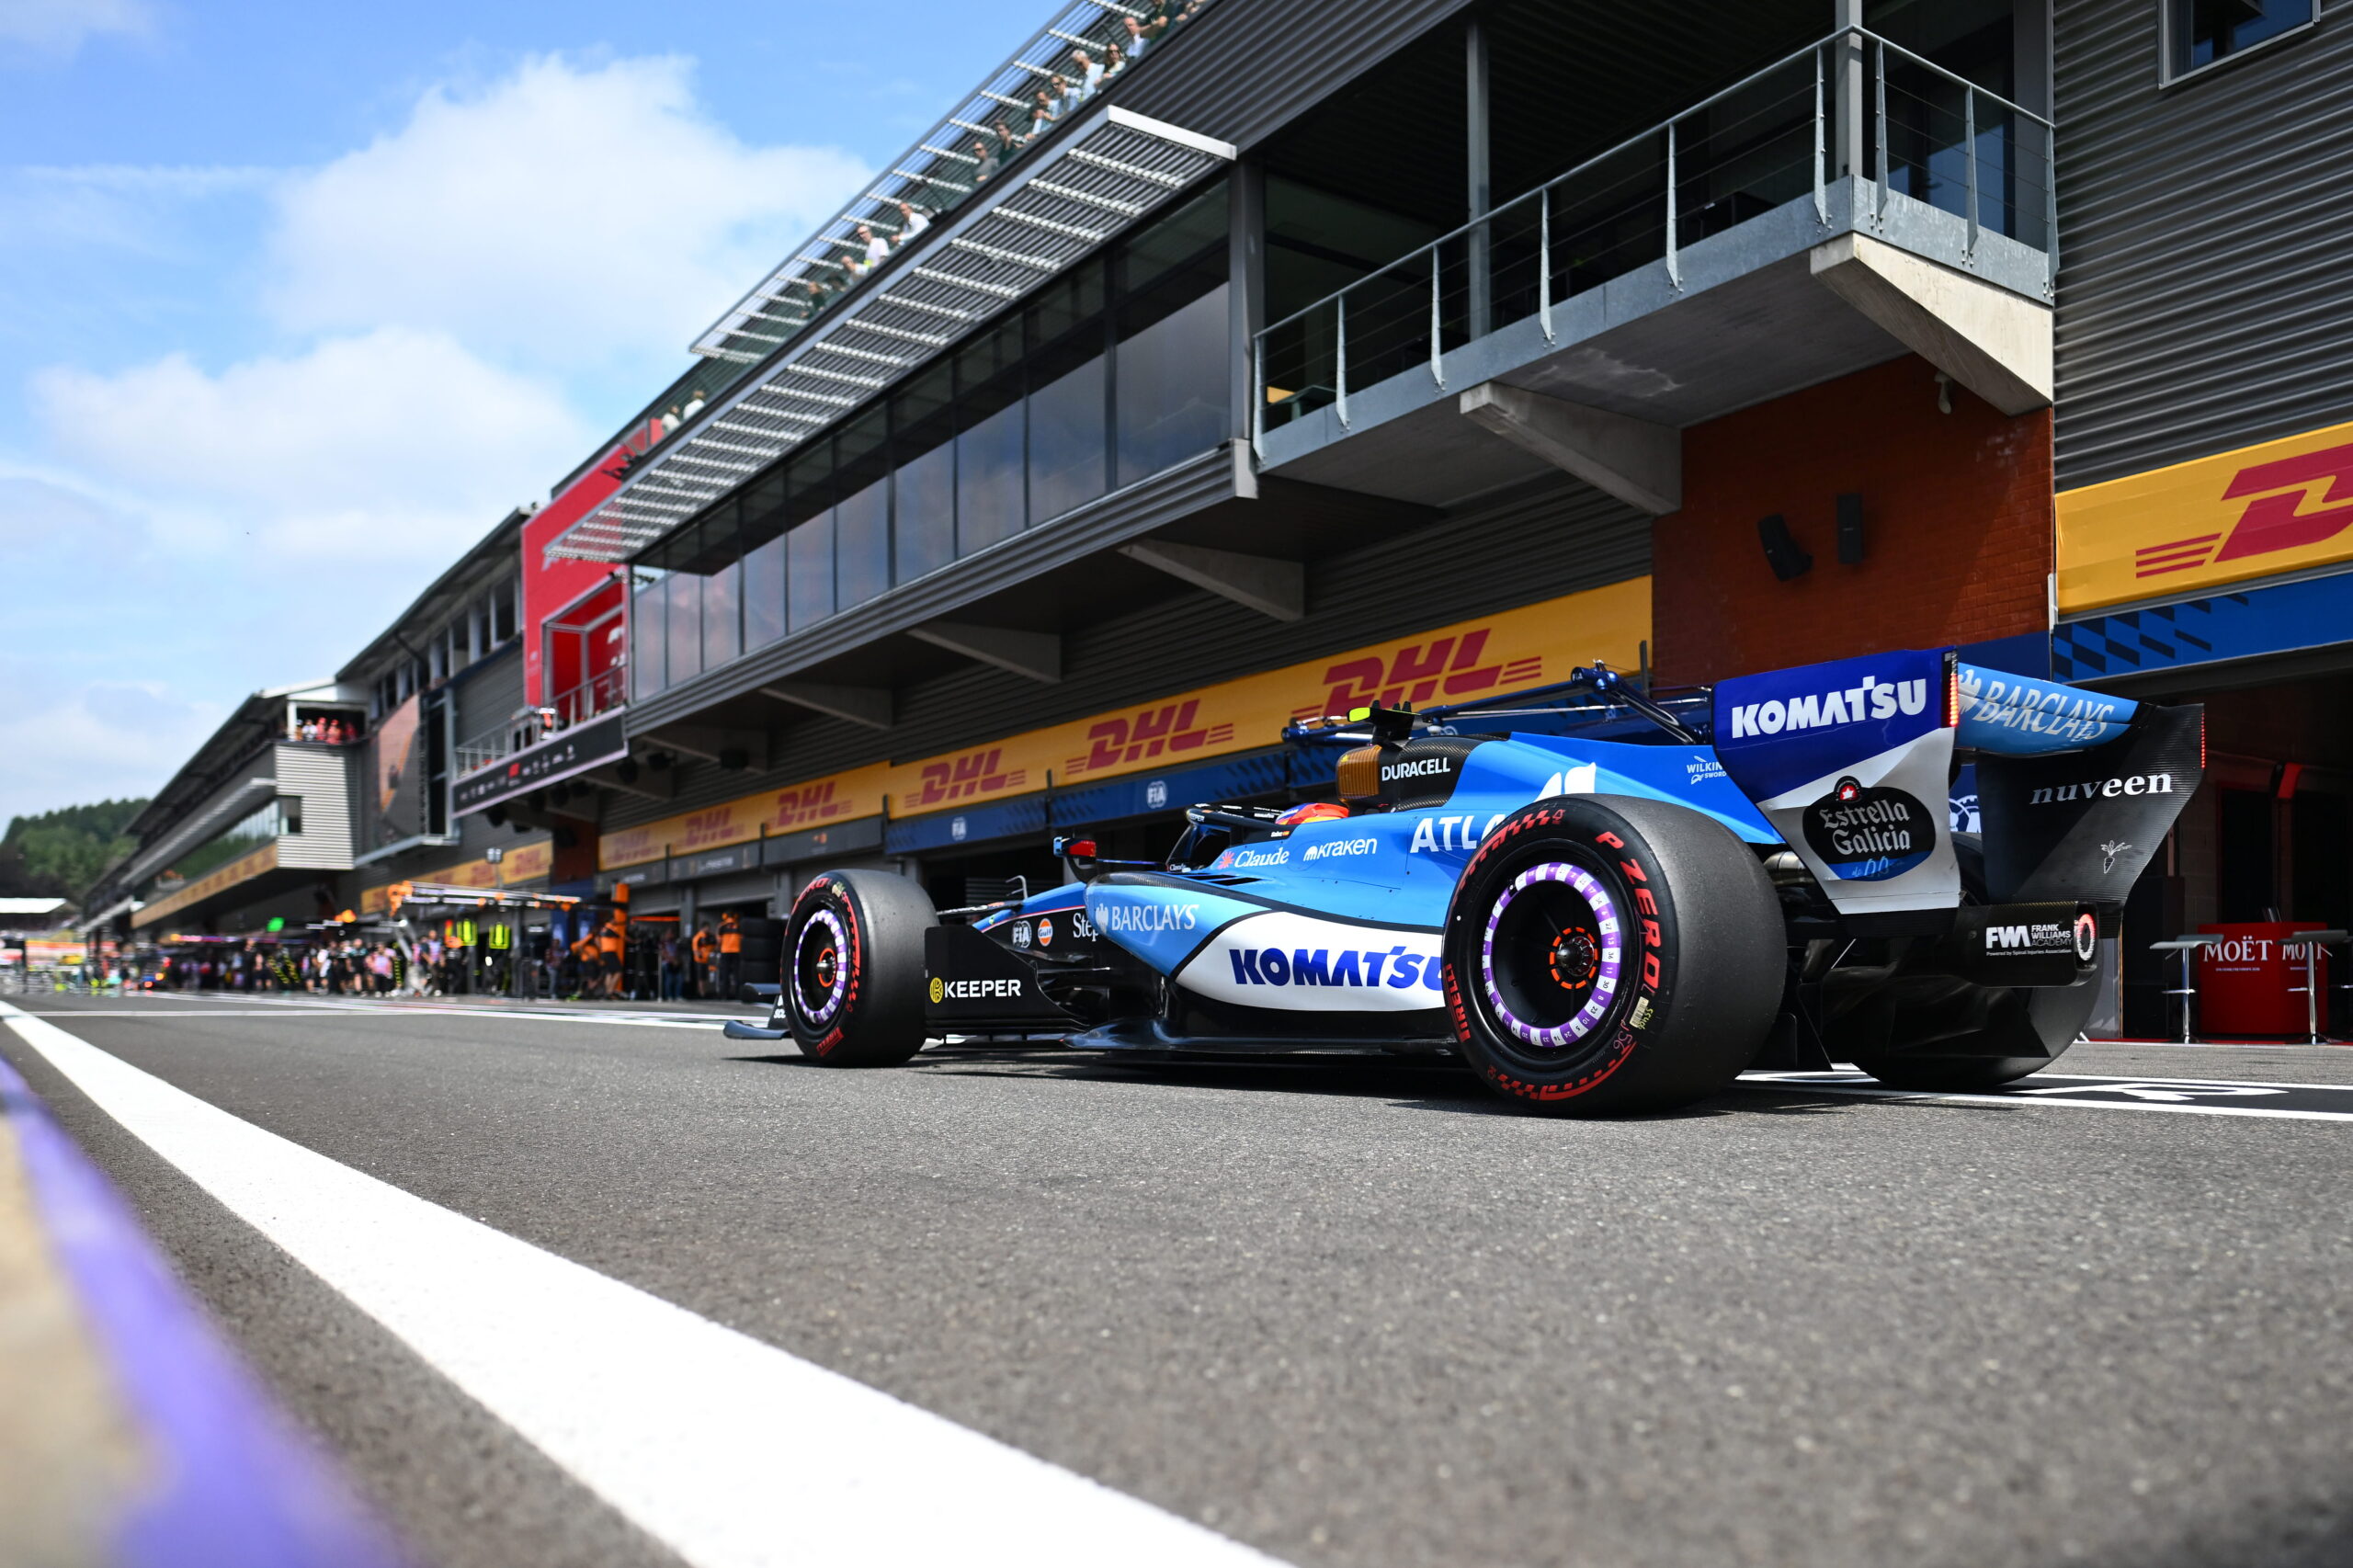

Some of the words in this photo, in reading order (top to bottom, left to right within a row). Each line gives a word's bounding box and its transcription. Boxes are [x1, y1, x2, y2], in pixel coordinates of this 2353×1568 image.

[1322, 628, 1504, 722] DHL
[1732, 676, 1927, 738] KOMATSU
[1973, 681, 2115, 742] BARCLAYS
[1086, 699, 1210, 770] DHL
[919, 747, 1007, 805] DHL
[1381, 757, 1450, 781] DURACELL
[1687, 762, 1722, 773] WILKIN
[2029, 772, 2173, 804] nuveen
[778, 782, 837, 826] DHL
[1819, 800, 1910, 829] Estrella
[683, 807, 733, 846] DHL
[1833, 824, 1911, 855] Galicia
[1234, 847, 1290, 868] Claude
[1111, 904, 1199, 931] BARCLAYS
[1596, 831, 1624, 848] P
[1620, 858, 1661, 989] ZERO
[1039, 928, 1052, 937] Gulf
[1073, 913, 1097, 941] Step
[2031, 924, 2059, 932] FRANK
[2031, 938, 2073, 947] ACADEMY
[2203, 936, 2273, 962] MOËT
[945, 980, 1021, 999] KEEPER
[1443, 963, 1471, 1043] PIRELLI
